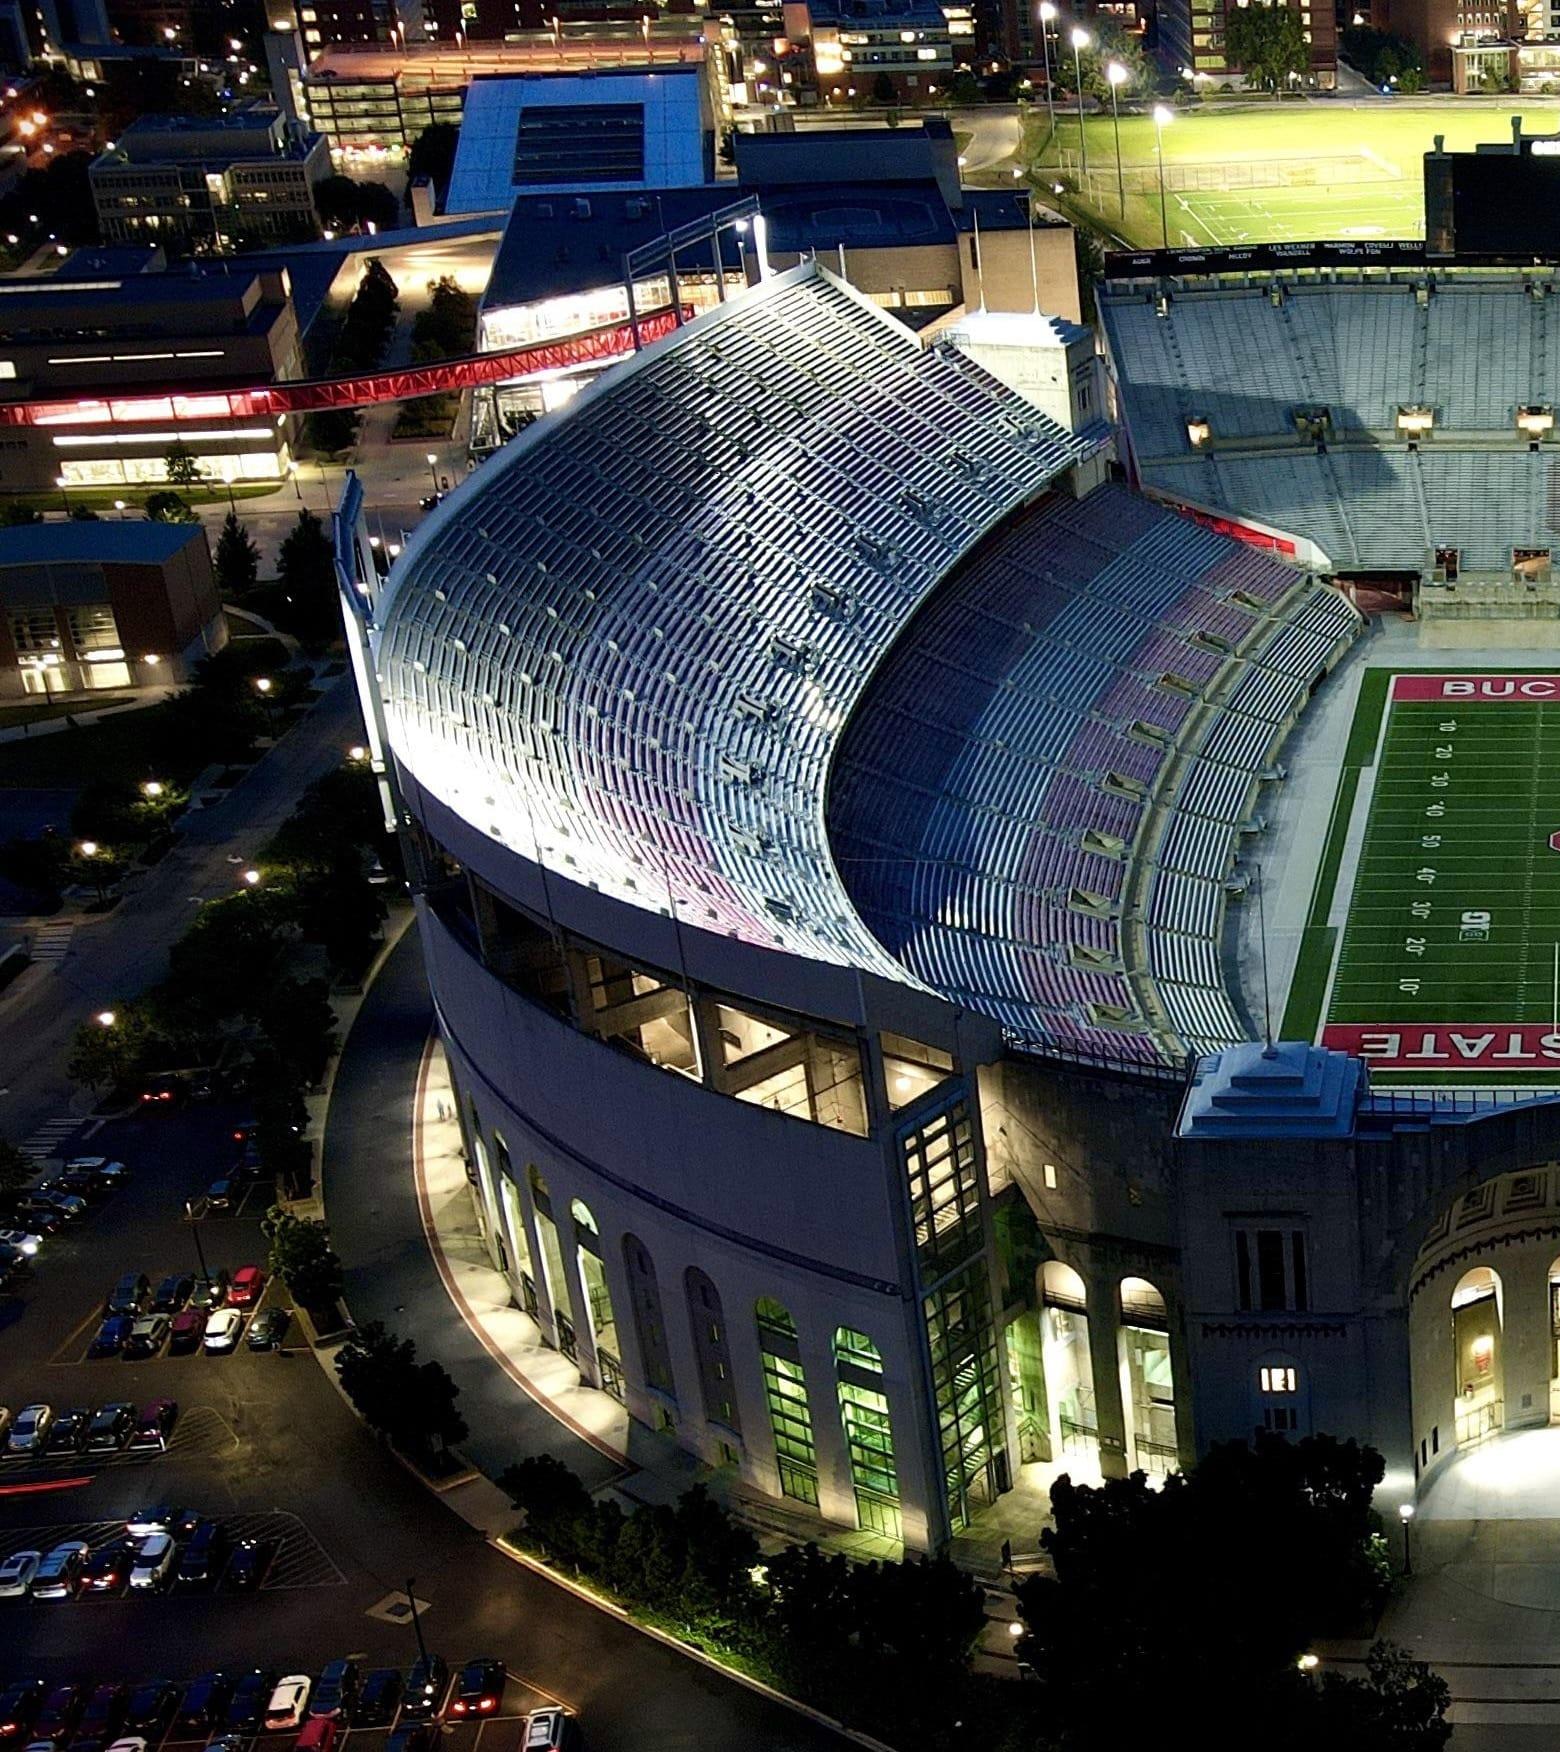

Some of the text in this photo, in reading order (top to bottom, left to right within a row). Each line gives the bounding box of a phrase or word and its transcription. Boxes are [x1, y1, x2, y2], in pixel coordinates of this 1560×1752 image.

[1421, 835, 1442, 848] 50
[1416, 867, 1437, 882] 40
[1411, 901, 1432, 917] 30
[1406, 937, 1426, 953] 20
[1399, 978, 1421, 992] 10
